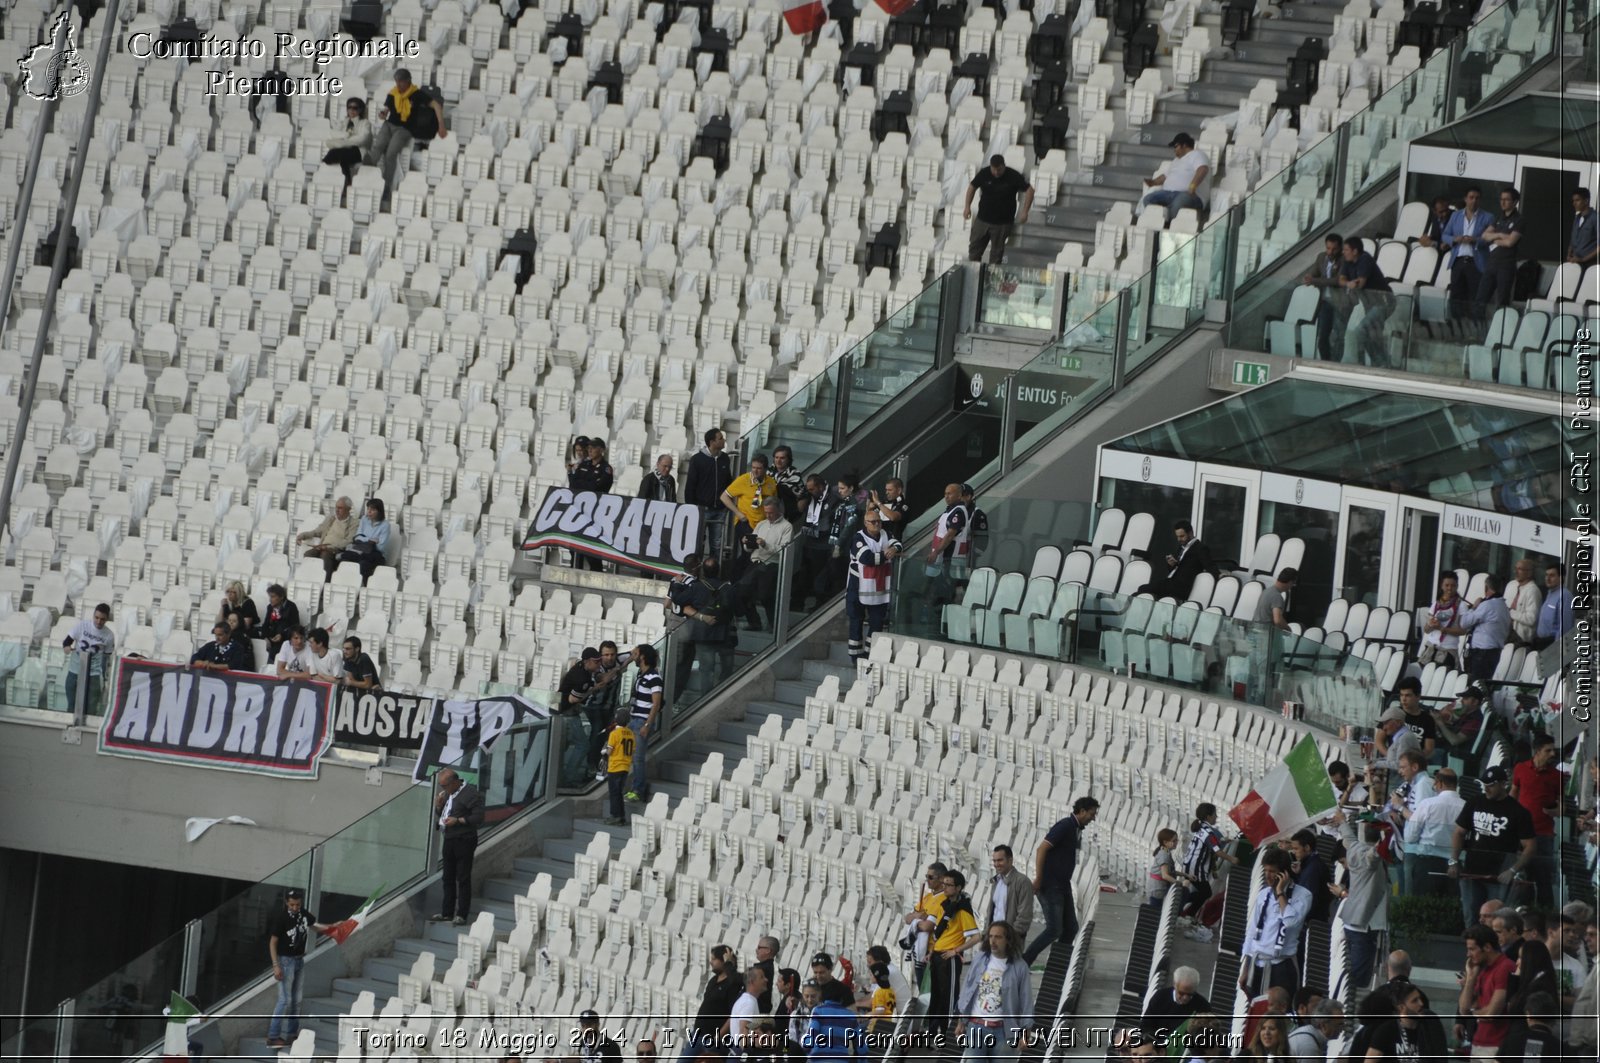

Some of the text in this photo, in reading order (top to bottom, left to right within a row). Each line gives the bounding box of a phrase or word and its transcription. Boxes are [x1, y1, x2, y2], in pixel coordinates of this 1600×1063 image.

[1047, 215, 1056, 224] 27
[904, 336, 913, 346] 24
[855, 377, 864, 387] 23
[995, 383, 1057, 405] JUENTUS
[806, 417, 816, 426] 22
[536, 488, 700, 564] CORATO
[1453, 513, 1501, 537] DAMILANO
[113, 671, 318, 760] ANDRIA
[335, 691, 433, 740] AOSTA
[620, 738, 634, 757] 10
